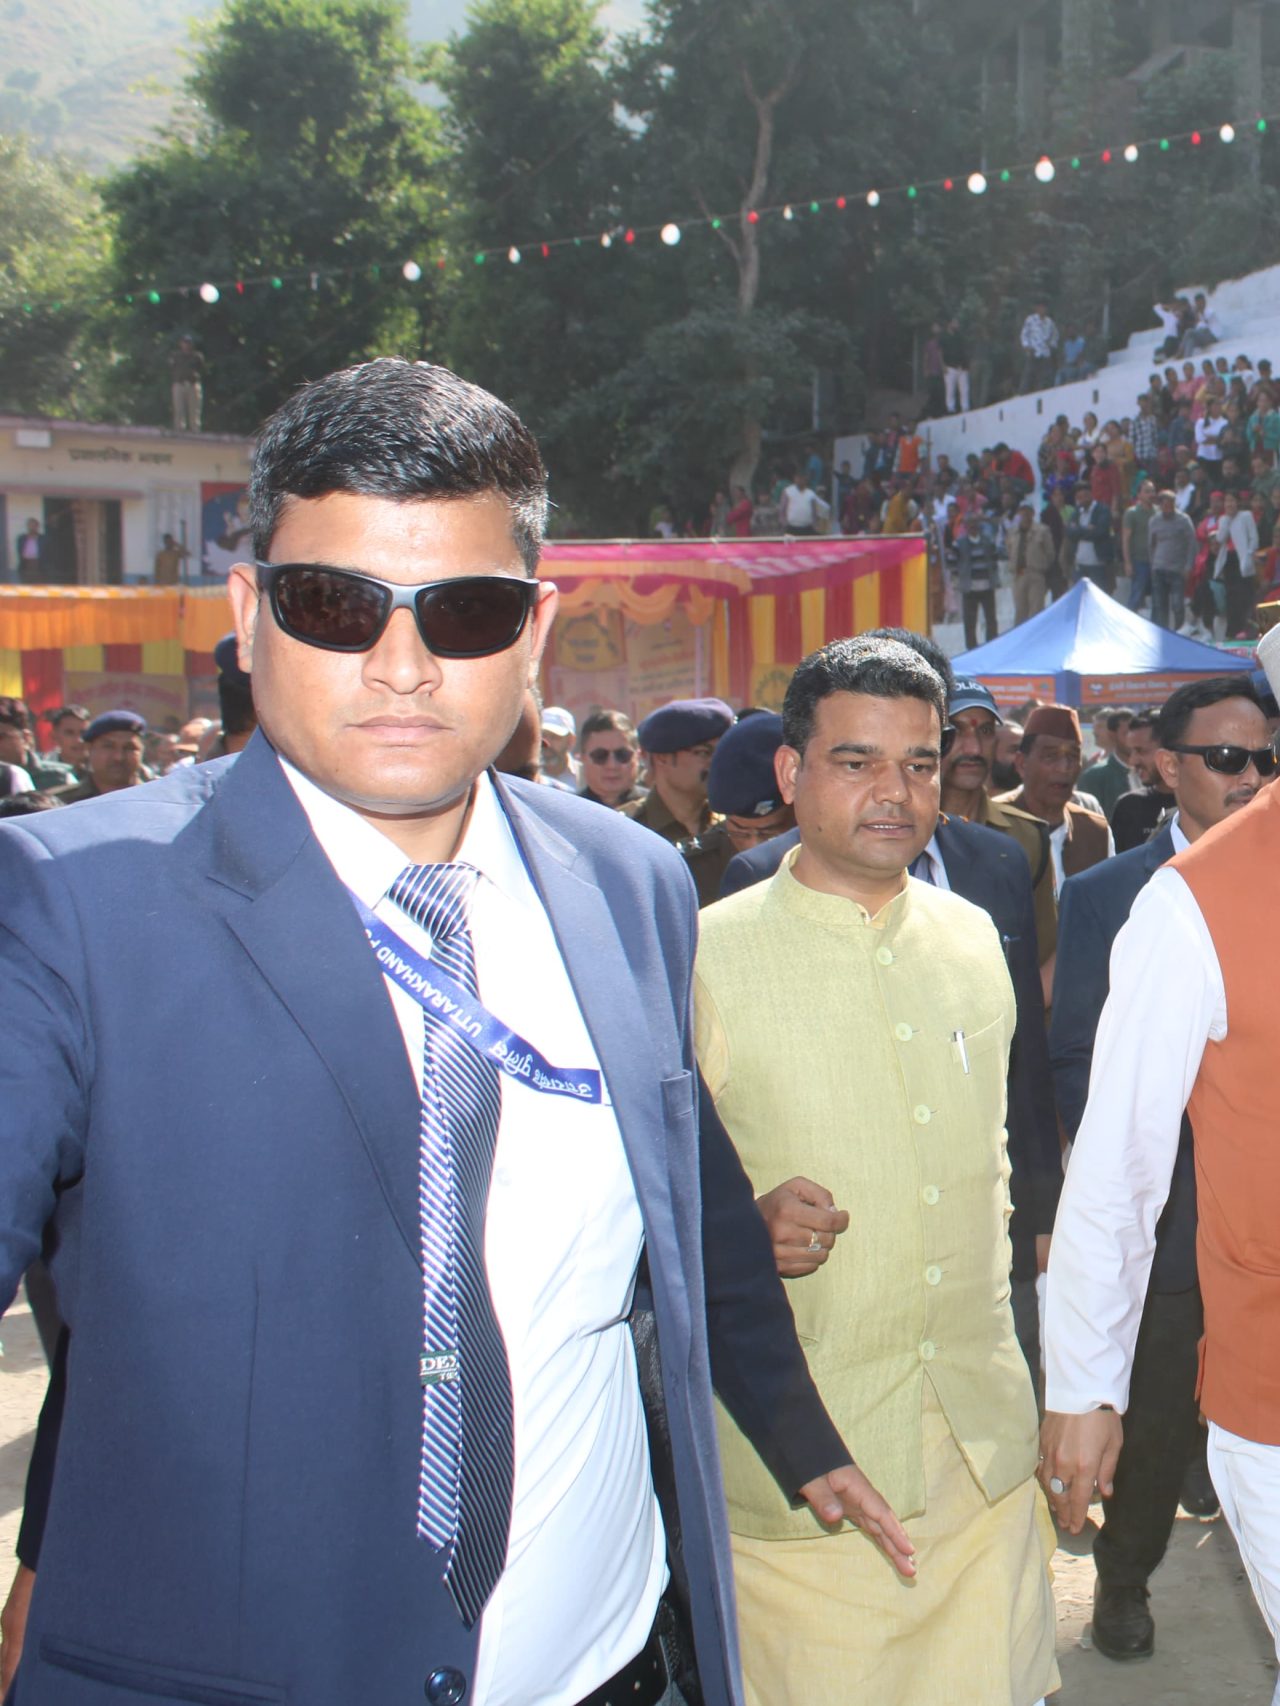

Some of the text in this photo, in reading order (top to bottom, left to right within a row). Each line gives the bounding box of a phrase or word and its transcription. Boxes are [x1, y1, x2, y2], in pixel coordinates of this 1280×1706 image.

[955, 681, 987, 694] OLICE
[376, 947, 483, 1038] UTTARAKHAND
[489, 1040, 593, 1097] उत्तराखंड पुलिस
